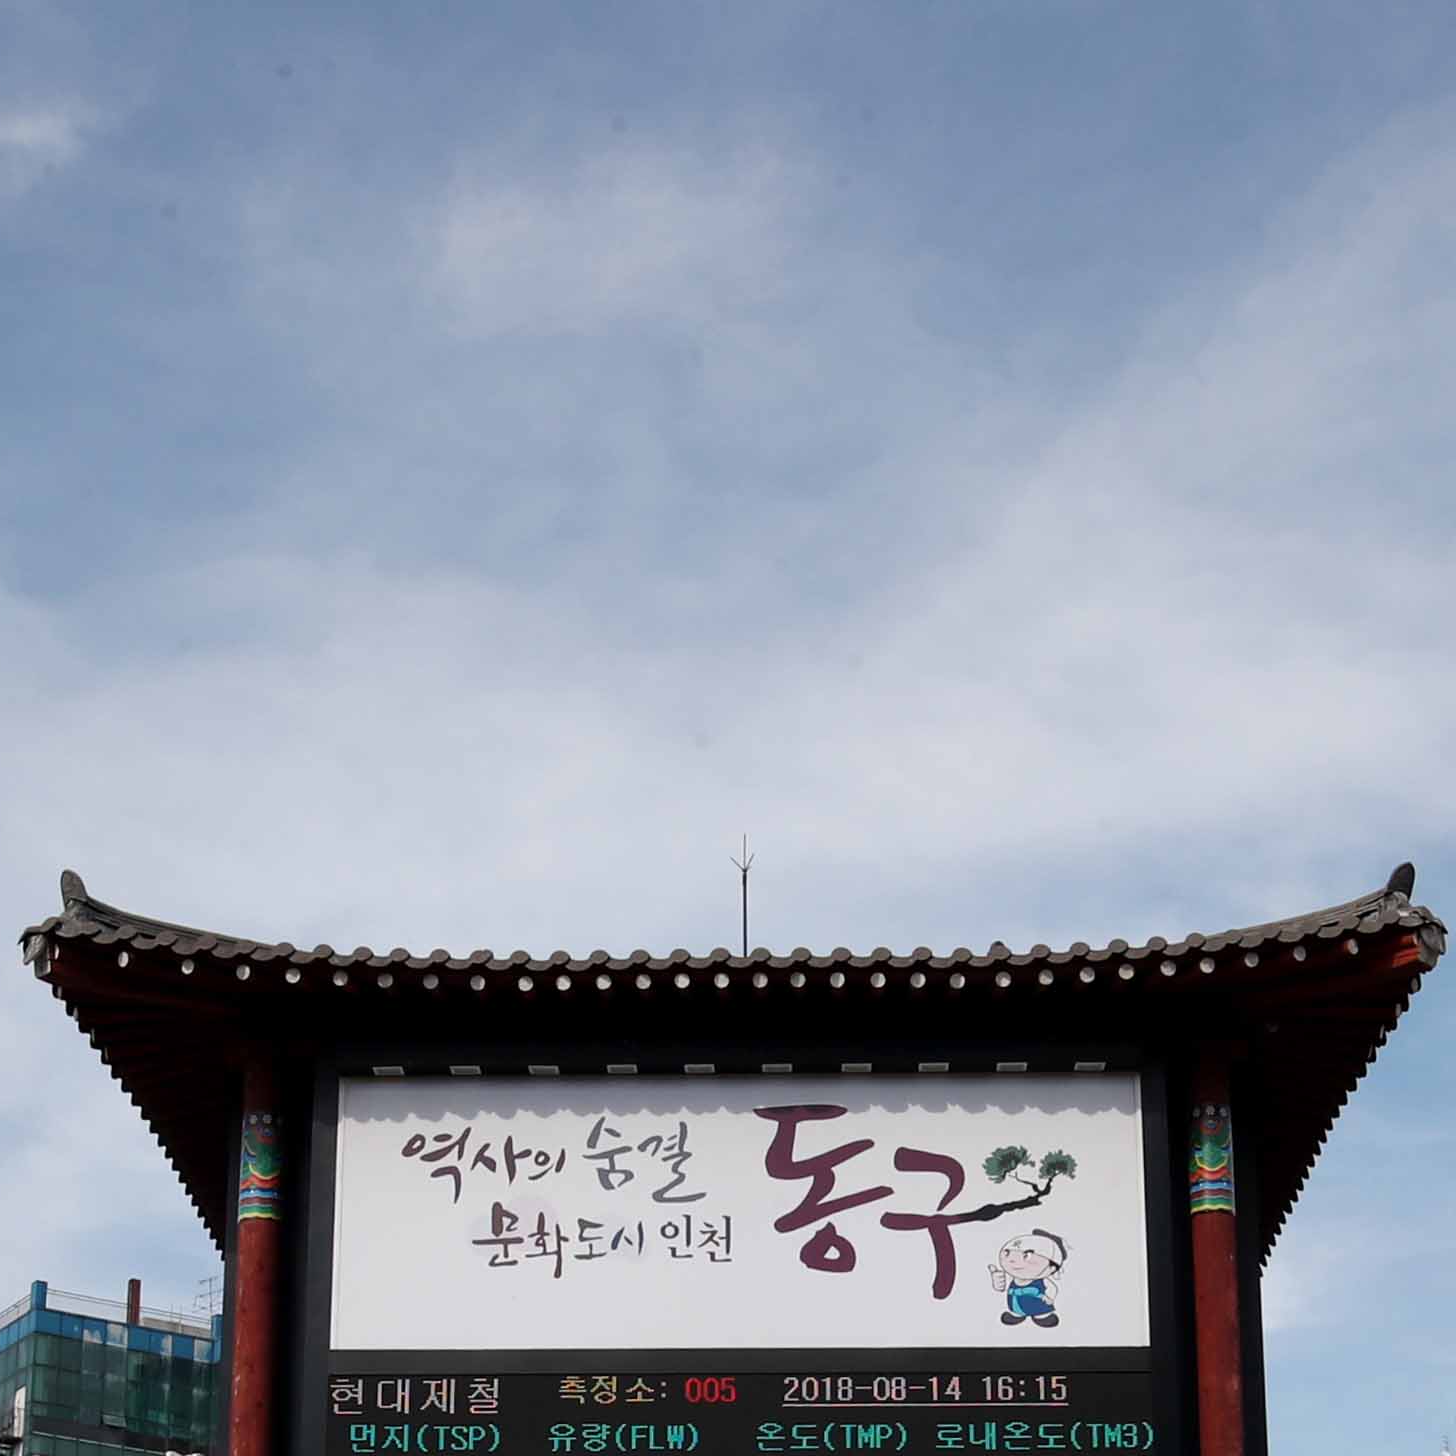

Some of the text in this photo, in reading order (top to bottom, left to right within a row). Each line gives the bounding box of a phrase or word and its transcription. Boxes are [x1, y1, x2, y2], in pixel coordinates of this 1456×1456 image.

[401, 1116, 707, 1204] 역사의 숨결
[472, 1201, 732, 1278] 문화도시 인천
[752, 1104, 966, 1300] 동구
[329, 1375, 1069, 1415] 현대제철 측정소: 005 2018-08-14 16:15
[349, 1423, 502, 1453] 먼지(TSP)
[756, 1423, 908, 1452] 온도(TMP)
[935, 1422, 1155, 1452] 로내온도(TM3)
